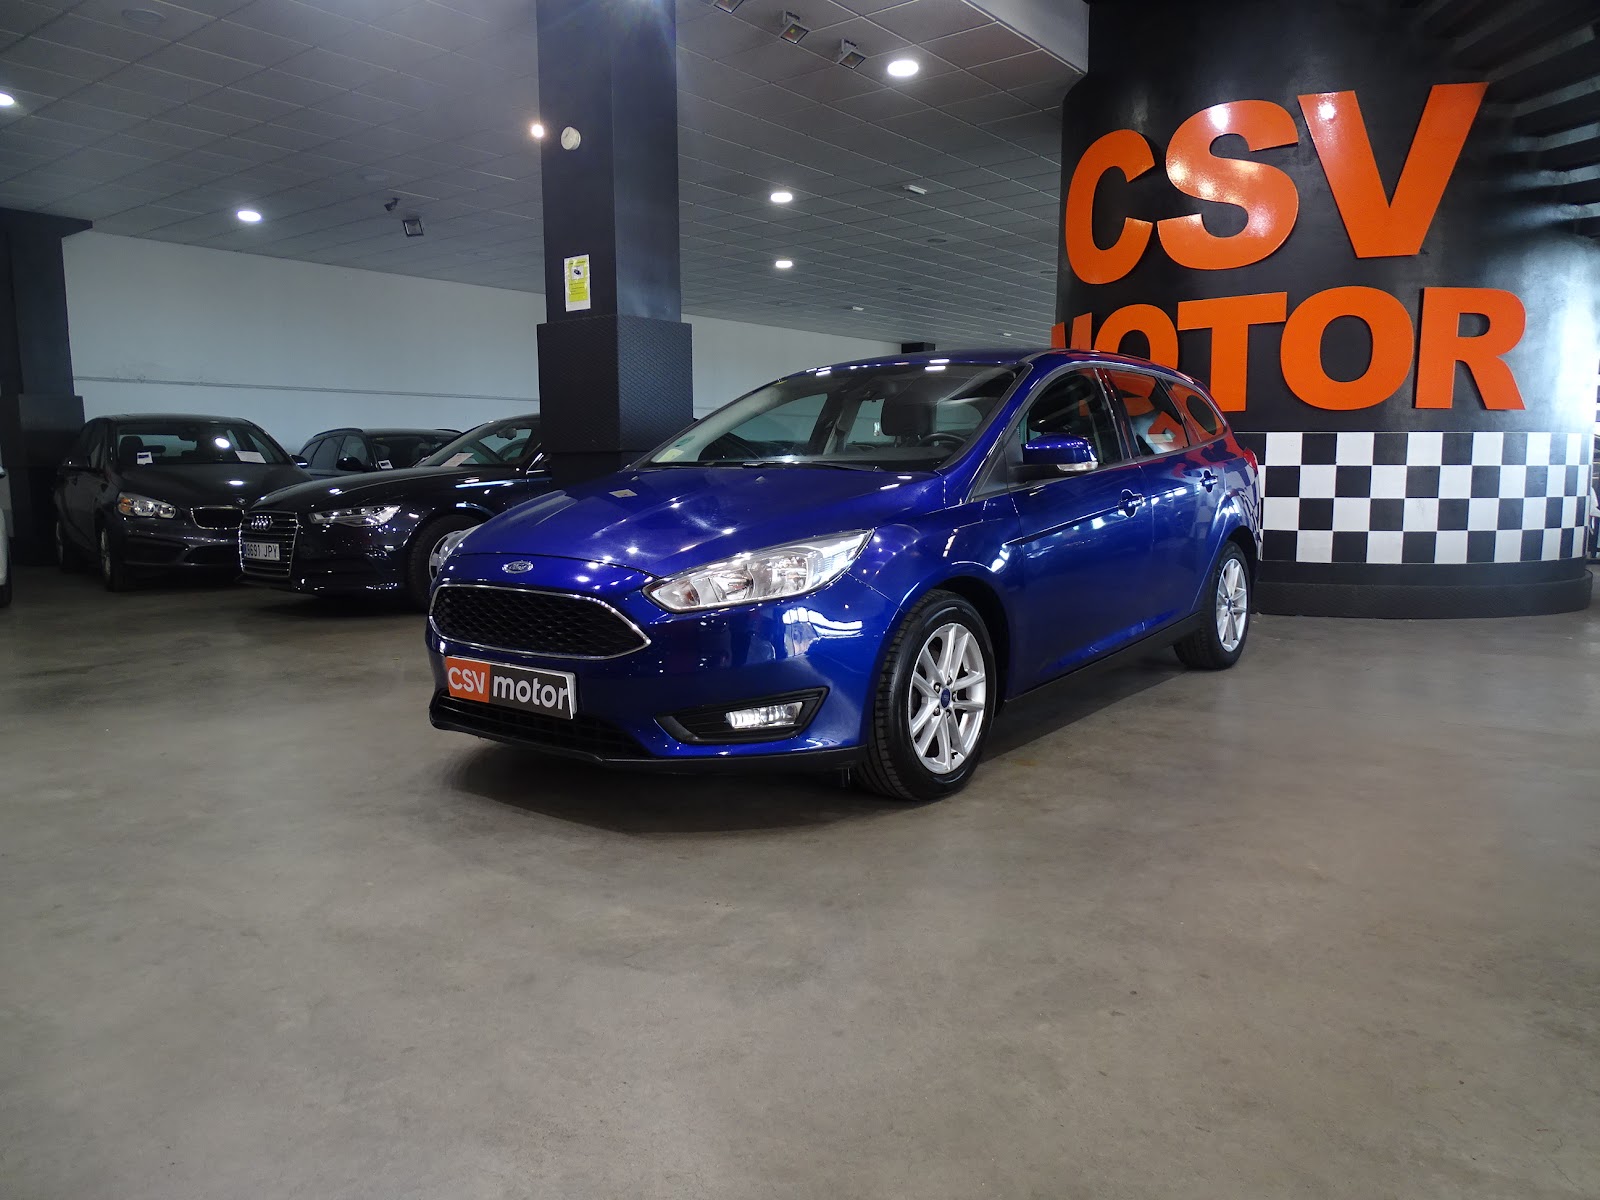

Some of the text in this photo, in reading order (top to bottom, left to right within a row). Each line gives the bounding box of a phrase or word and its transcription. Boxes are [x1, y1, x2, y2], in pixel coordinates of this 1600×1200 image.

[1065, 82, 1489, 285] CSV
[263, 544, 278, 559] JPY
[447, 666, 567, 710] CSV motor
